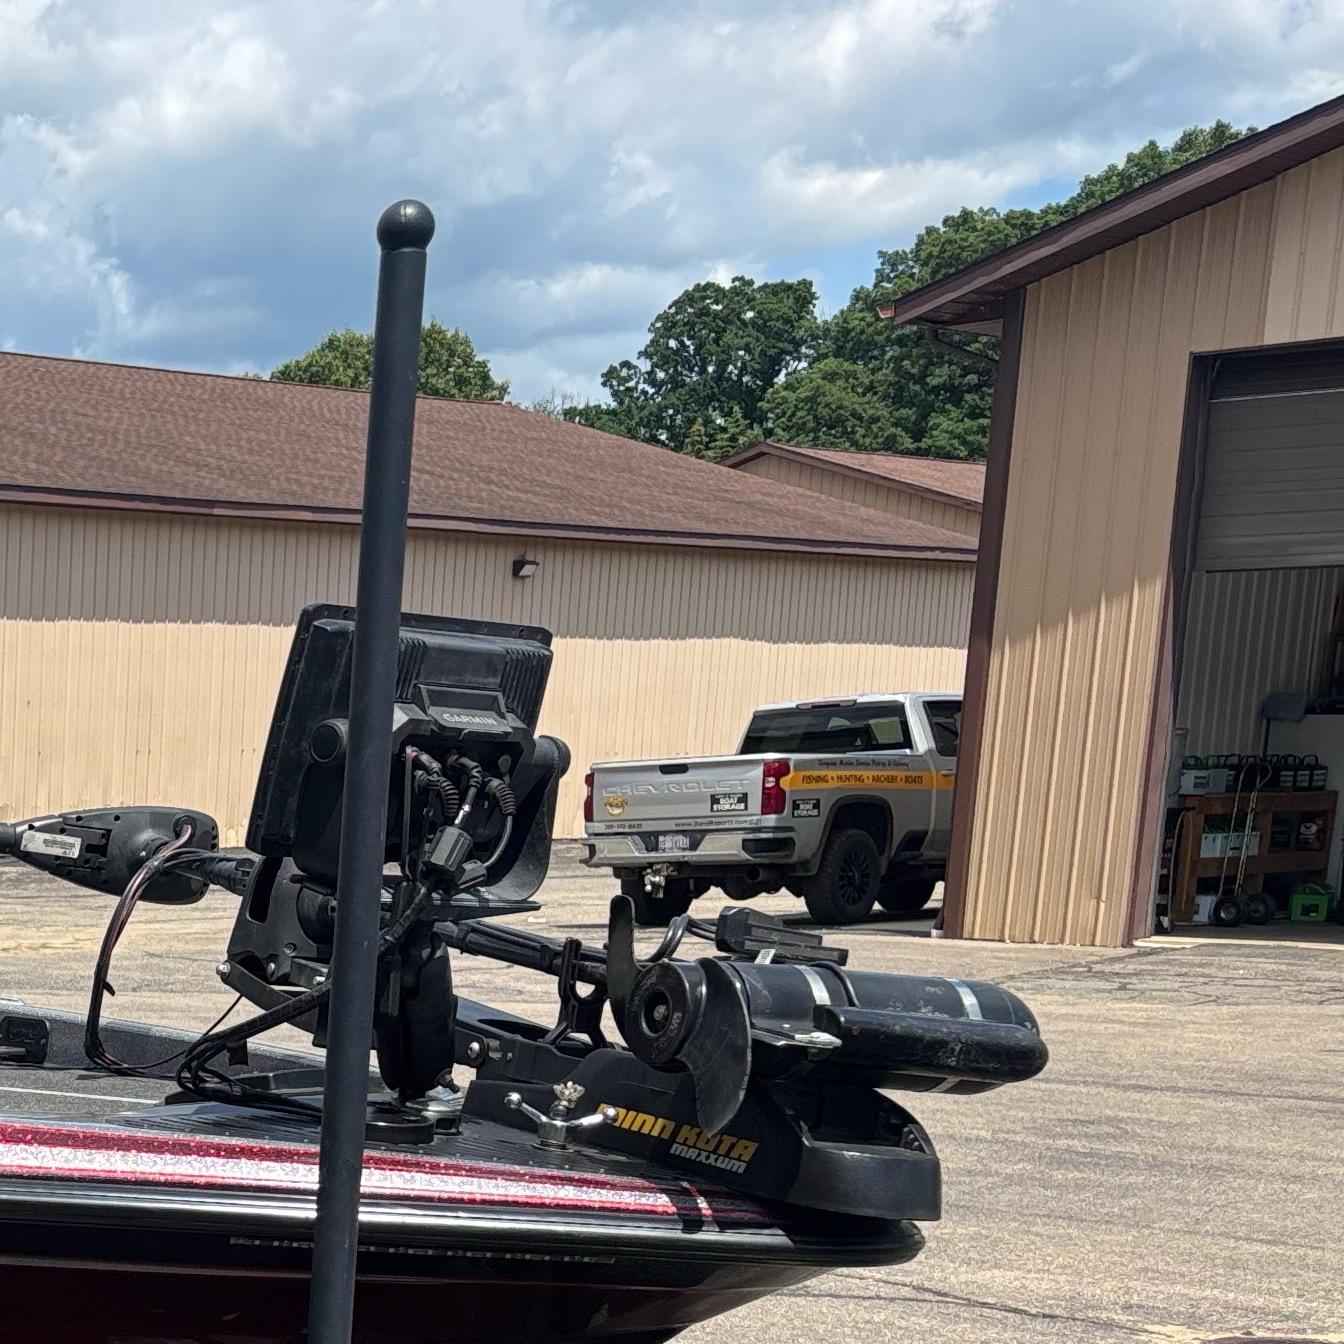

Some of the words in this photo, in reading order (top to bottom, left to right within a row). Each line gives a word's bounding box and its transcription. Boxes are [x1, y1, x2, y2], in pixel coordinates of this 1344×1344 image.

[442, 712, 498, 725] GARMIN
[802, 774, 829, 784] FISHING
[601, 780, 750, 796] CHEVROLET
[675, 1124, 760, 1162] KOTA
[669, 1143, 748, 1174] MAXXUM
